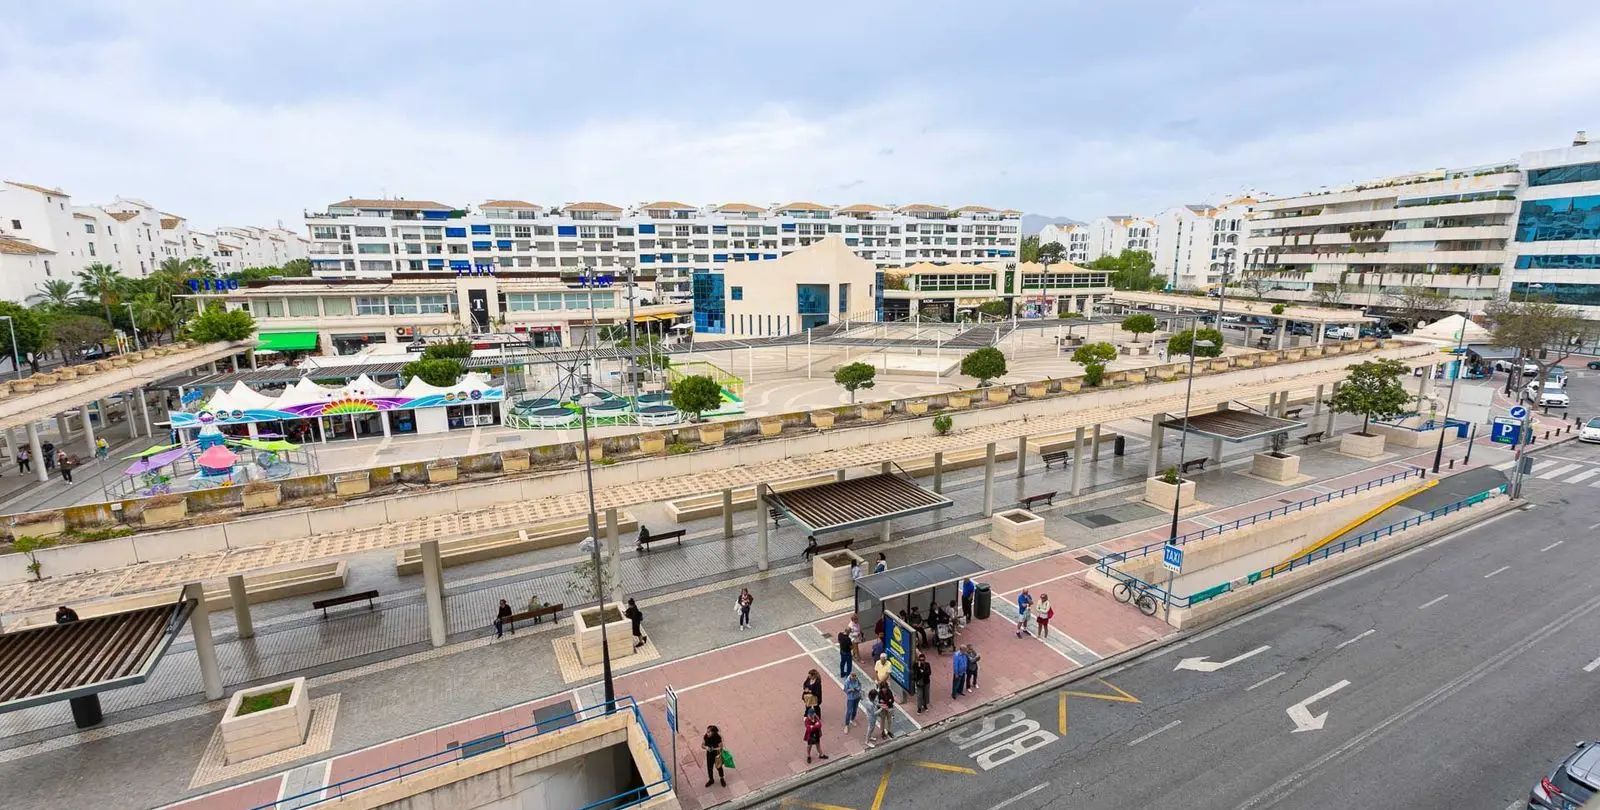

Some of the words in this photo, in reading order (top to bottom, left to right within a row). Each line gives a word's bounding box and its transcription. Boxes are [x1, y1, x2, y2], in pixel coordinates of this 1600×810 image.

[456, 264, 496, 276] TIBU
[187, 278, 238, 291] TIBU
[473, 298, 484, 309] T
[1501, 424, 1513, 436] P
[1166, 548, 1181, 564] TAXI
[949, 708, 1060, 771] BUS
